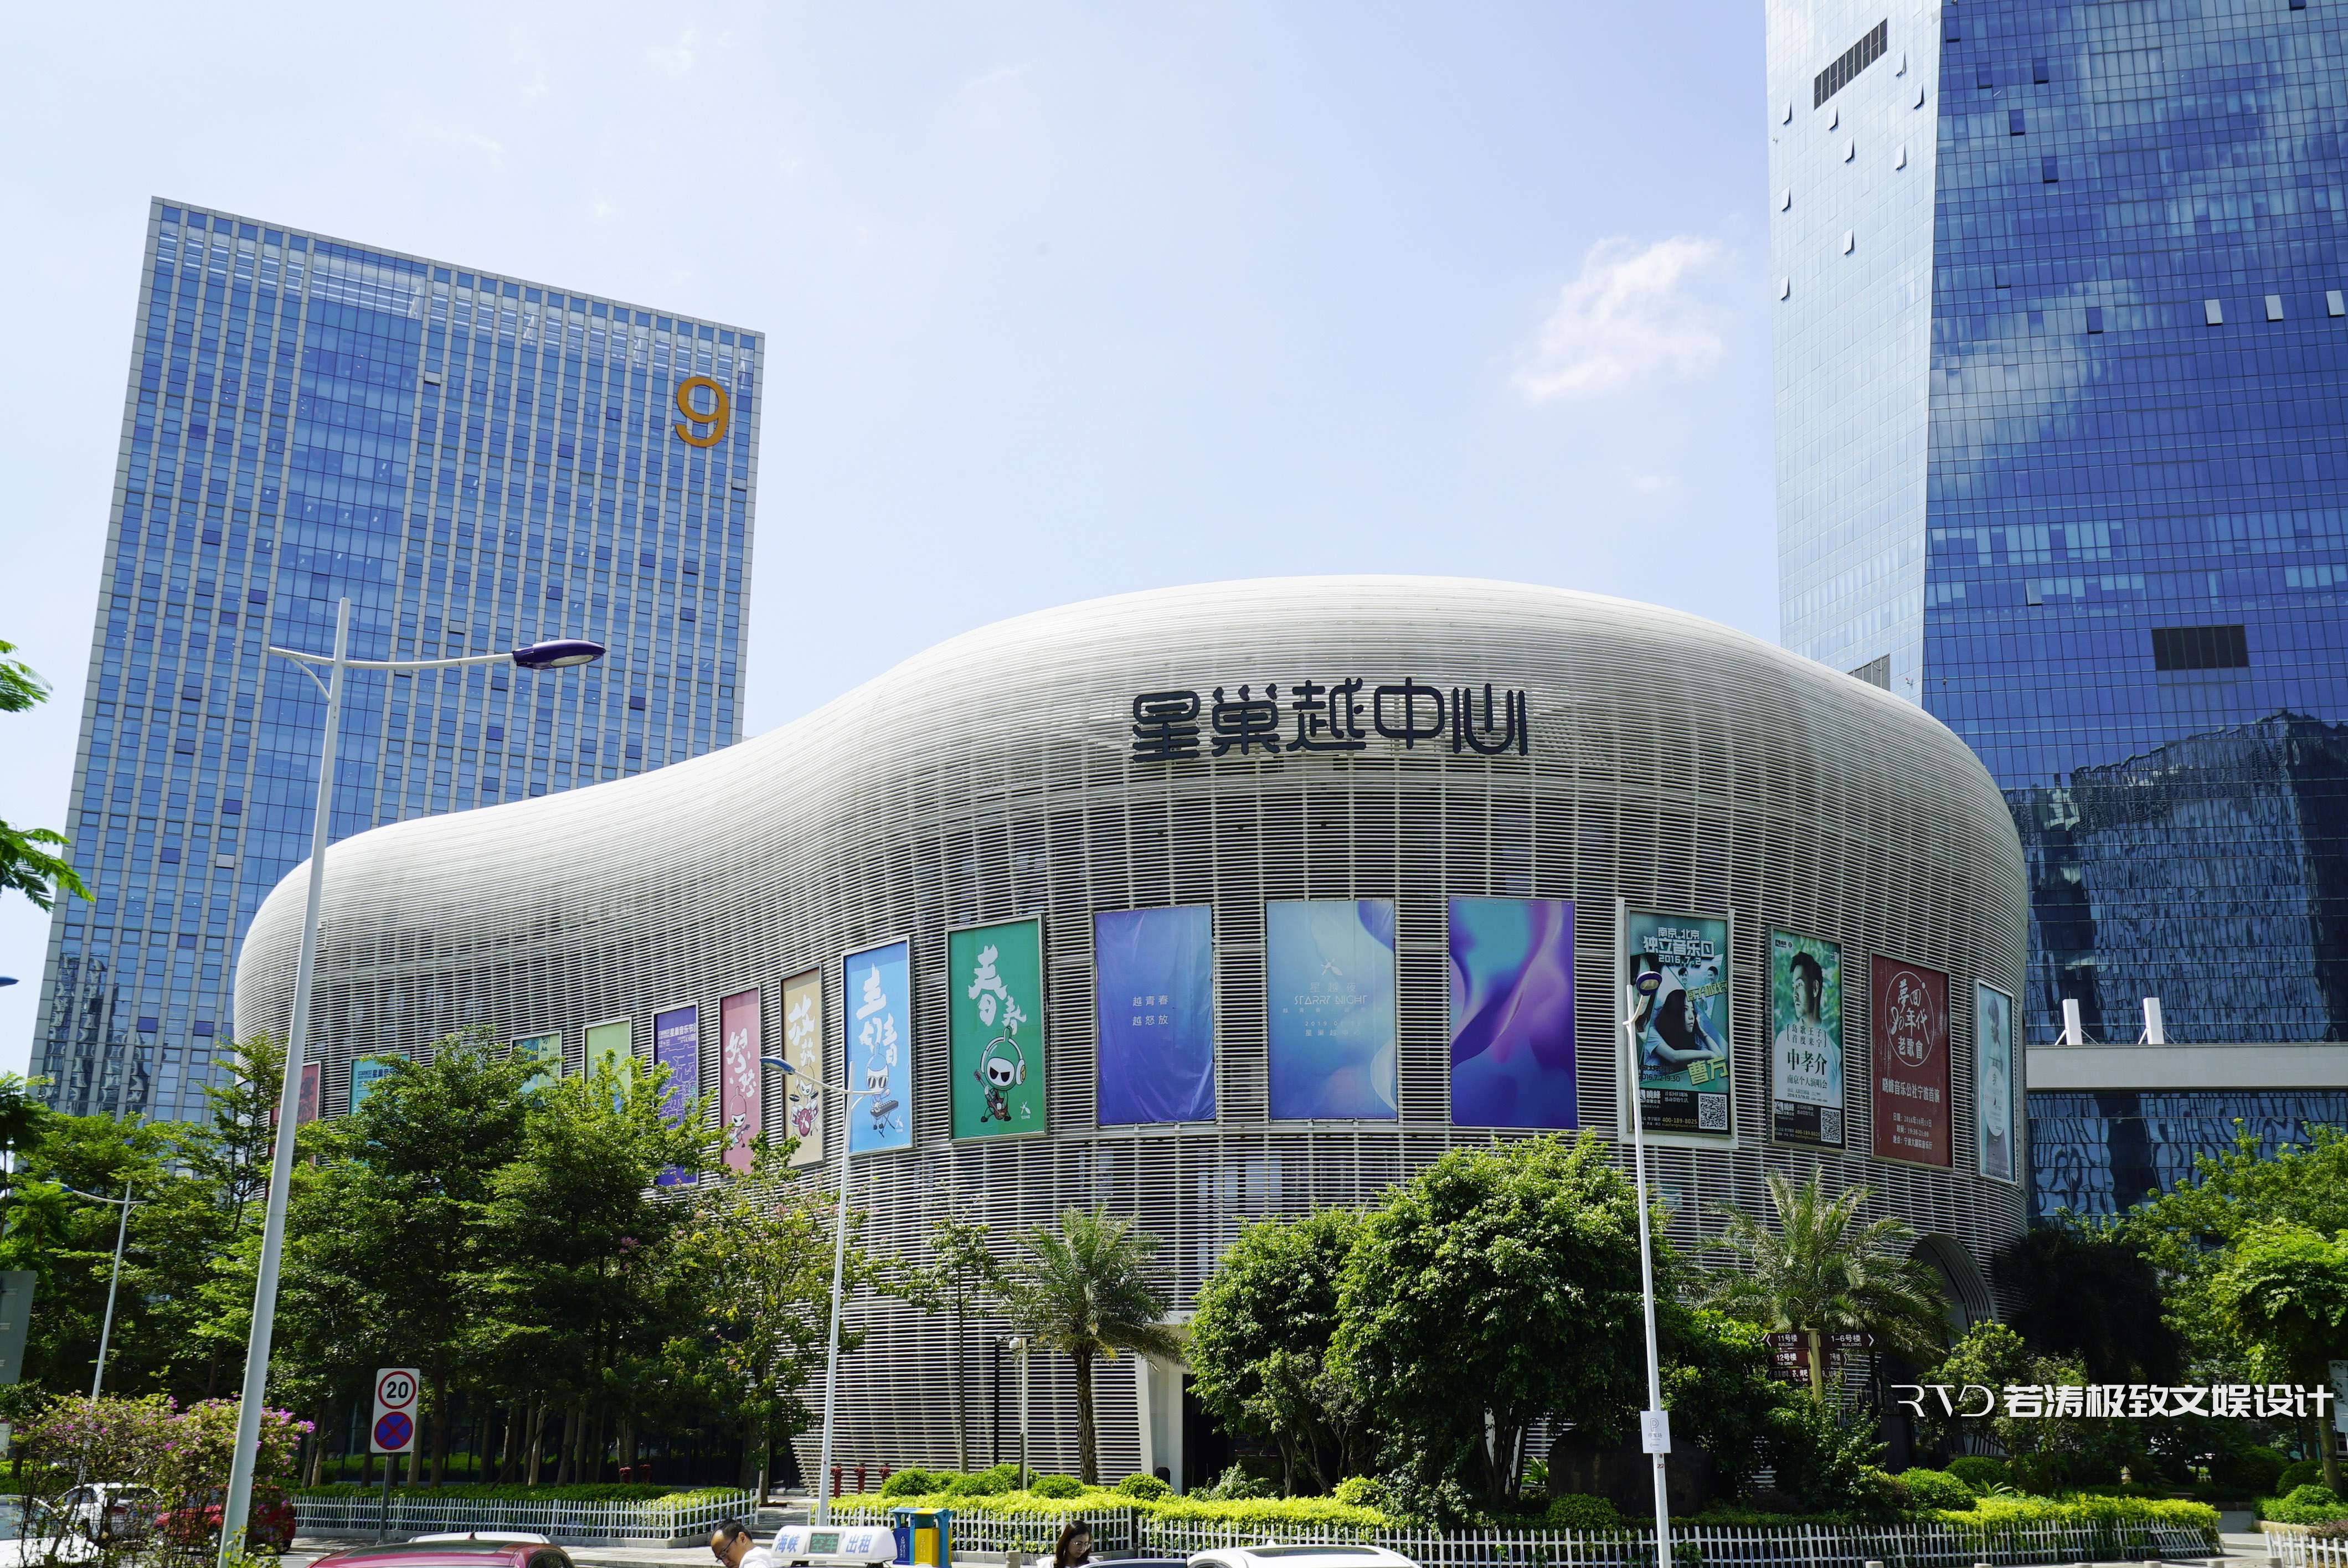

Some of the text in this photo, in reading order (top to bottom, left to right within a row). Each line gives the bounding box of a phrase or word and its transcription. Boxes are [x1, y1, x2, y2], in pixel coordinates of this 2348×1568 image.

[675, 376, 730, 448] 9
[1132, 677, 1528, 761] 星巢越中心
[1659, 955, 1701, 965] 2016.7.2
[1132, 995, 1168, 1007] 越青春
[1335, 995, 1368, 1005] NIGHT
[1132, 1014, 1168, 1026] 越怒放
[1792, 1023, 1822, 1037] 岛歌王子
[1792, 1035, 1822, 1048] 首度来宁
[1898, 1035, 1923, 1060] 老歌會
[1787, 1049, 1827, 1075] 中孝介
[1687, 1056, 1728, 1085] 曹方
[1787, 1075, 1827, 1089] 南京个人演唱会
[1778, 1334, 1798, 1343] 11号楼
[1777, 1353, 1797, 1361] 12号楼
[387, 1381, 409, 1399] 20
[775, 1533, 801, 1553] 海峡
[846, 1534, 873, 1553] 出租
